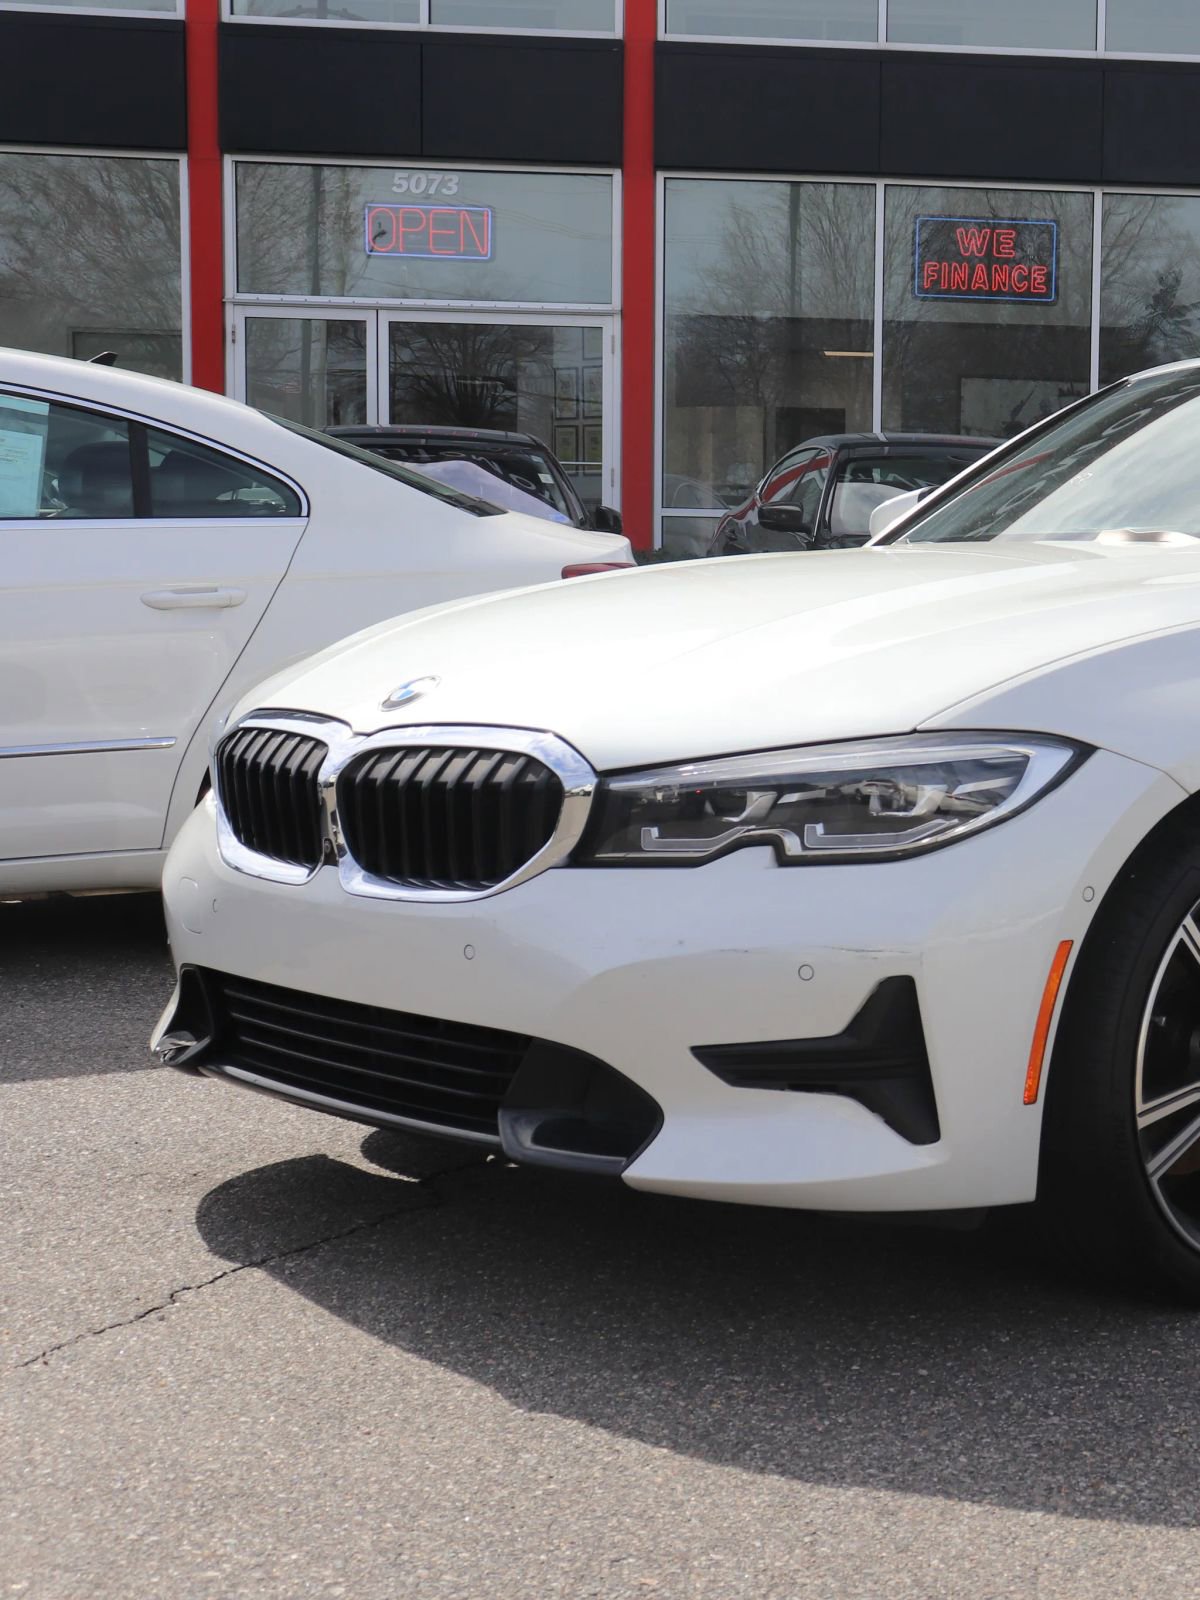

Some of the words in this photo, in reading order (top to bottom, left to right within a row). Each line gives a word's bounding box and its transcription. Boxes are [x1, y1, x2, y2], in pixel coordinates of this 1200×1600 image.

[392, 172, 460, 195] 5073
[368, 207, 489, 255] OPEN
[956, 228, 1016, 258] WE
[923, 261, 1047, 293] FINANCE
